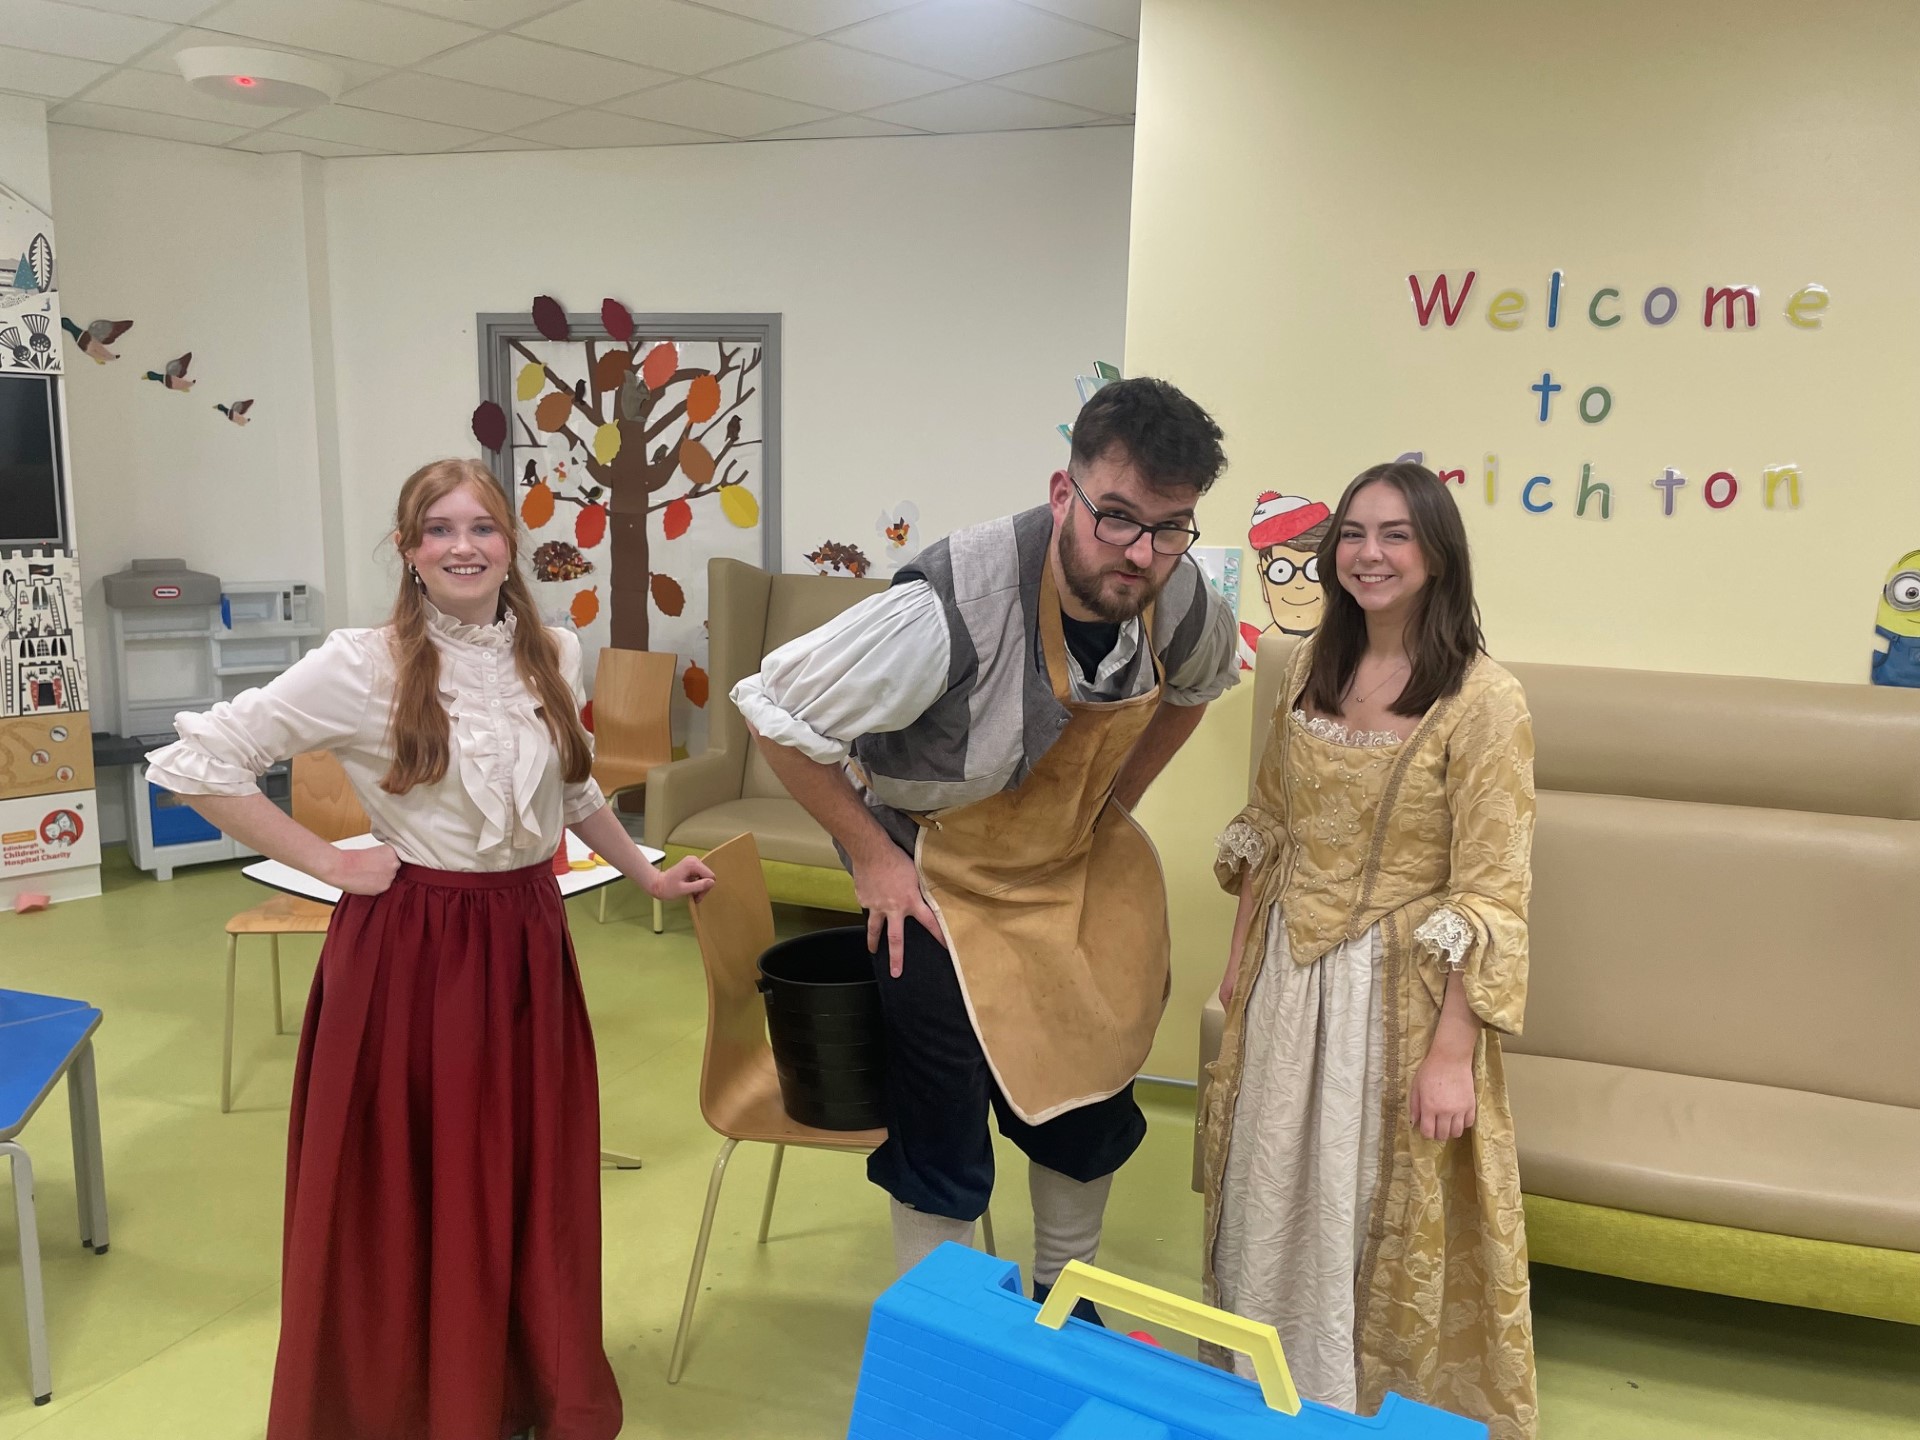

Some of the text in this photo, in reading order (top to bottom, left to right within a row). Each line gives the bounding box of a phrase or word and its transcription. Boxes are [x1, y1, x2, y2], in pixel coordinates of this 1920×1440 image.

[1408, 270, 1830, 329] Welcome
[1531, 372, 1612, 424] to
[1394, 451, 1801, 519] richton
[4, 848, 45, 859] Children's
[4, 852, 71, 866] Hospital Charity
